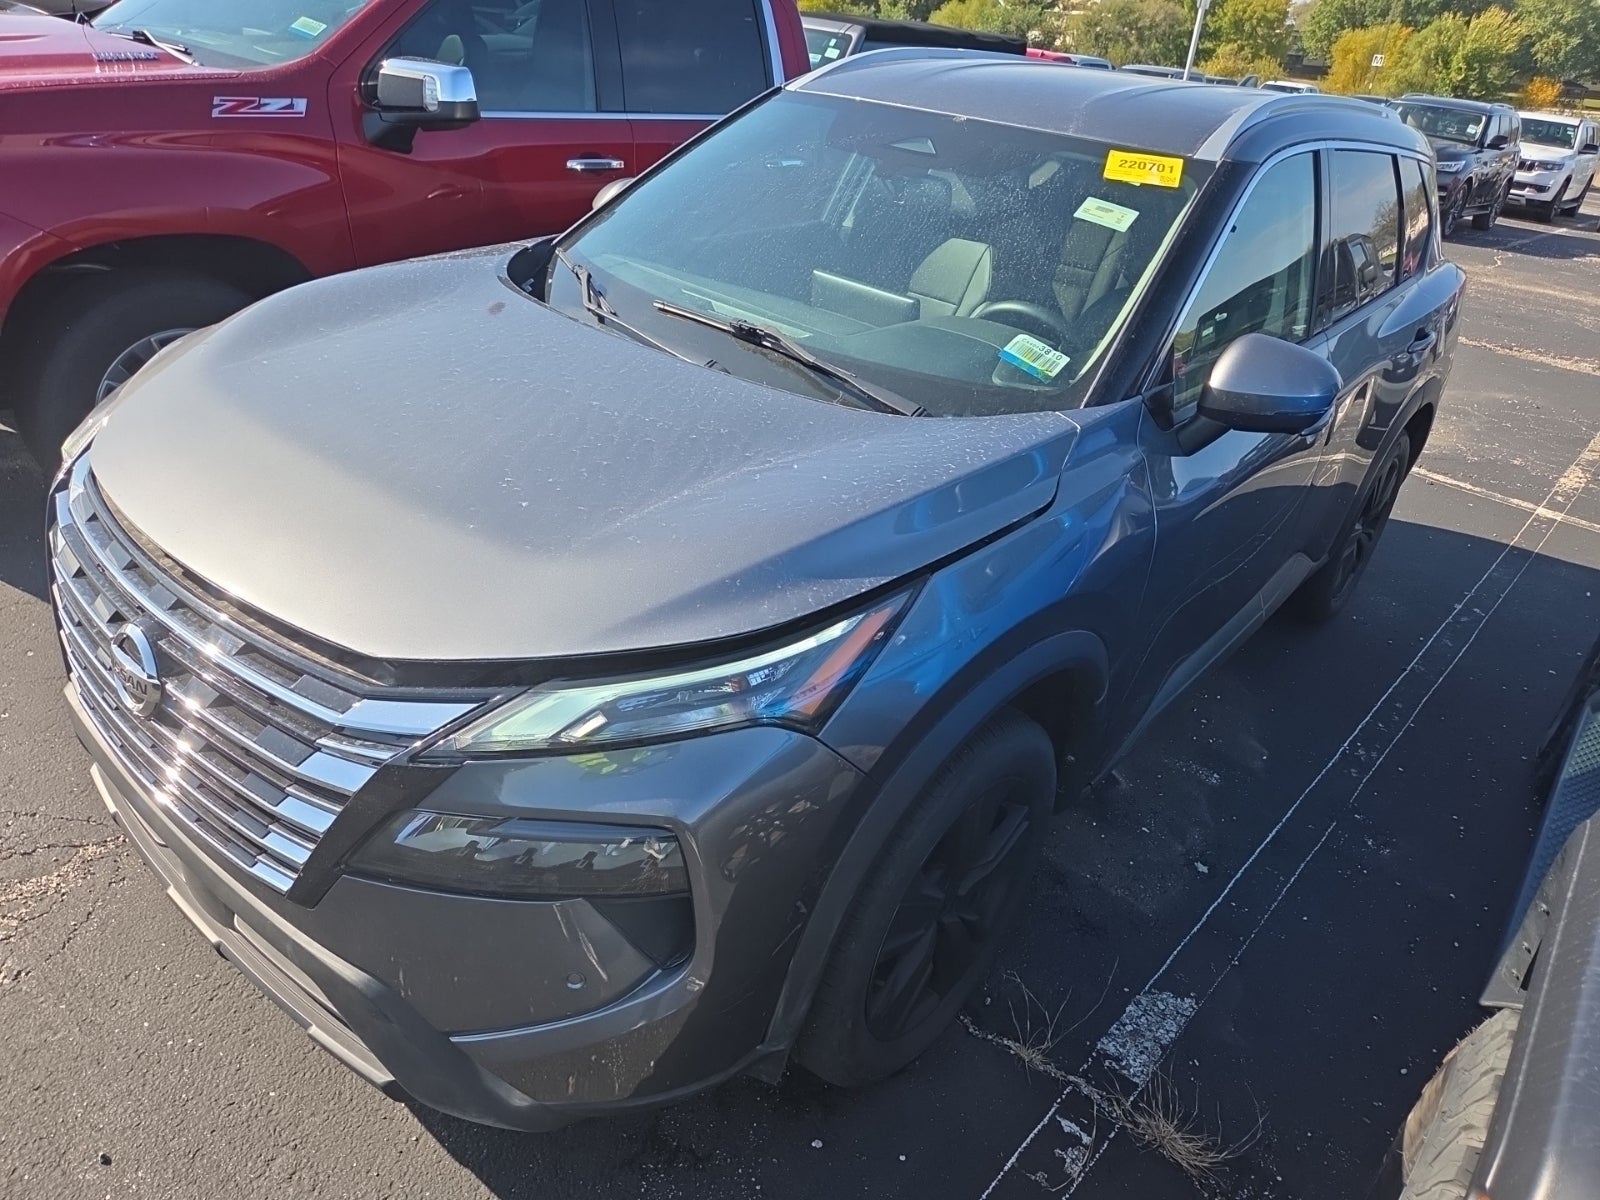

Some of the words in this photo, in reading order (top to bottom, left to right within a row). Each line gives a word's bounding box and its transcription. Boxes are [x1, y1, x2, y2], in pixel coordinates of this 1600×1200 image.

[211, 96, 307, 117] Z71
[1118, 159, 1175, 174] 220701
[112, 660, 148, 696] SSAN
